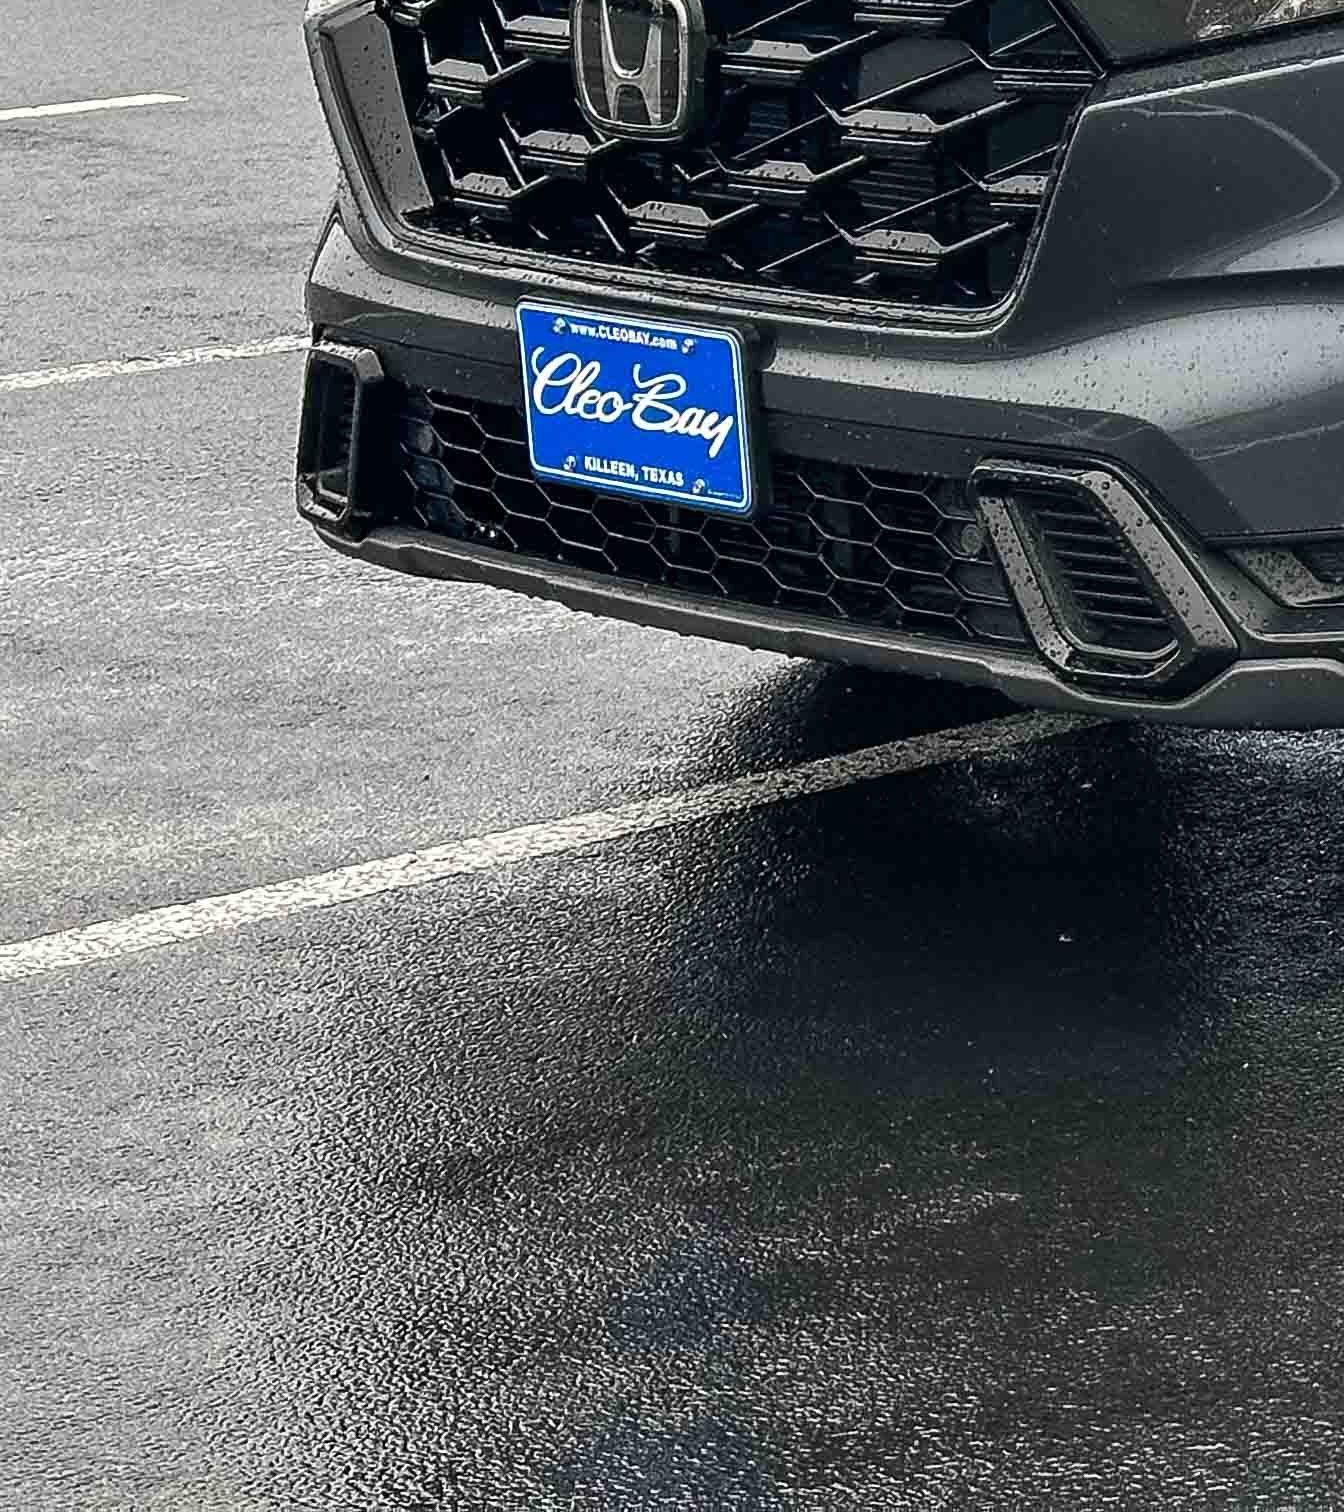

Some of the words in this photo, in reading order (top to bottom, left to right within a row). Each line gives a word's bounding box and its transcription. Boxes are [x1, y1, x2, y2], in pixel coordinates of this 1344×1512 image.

[569, 322, 678, 350] www.CLEOBAY.com
[584, 455, 639, 481] KILLEEN,
[640, 465, 685, 488] TEXAS
